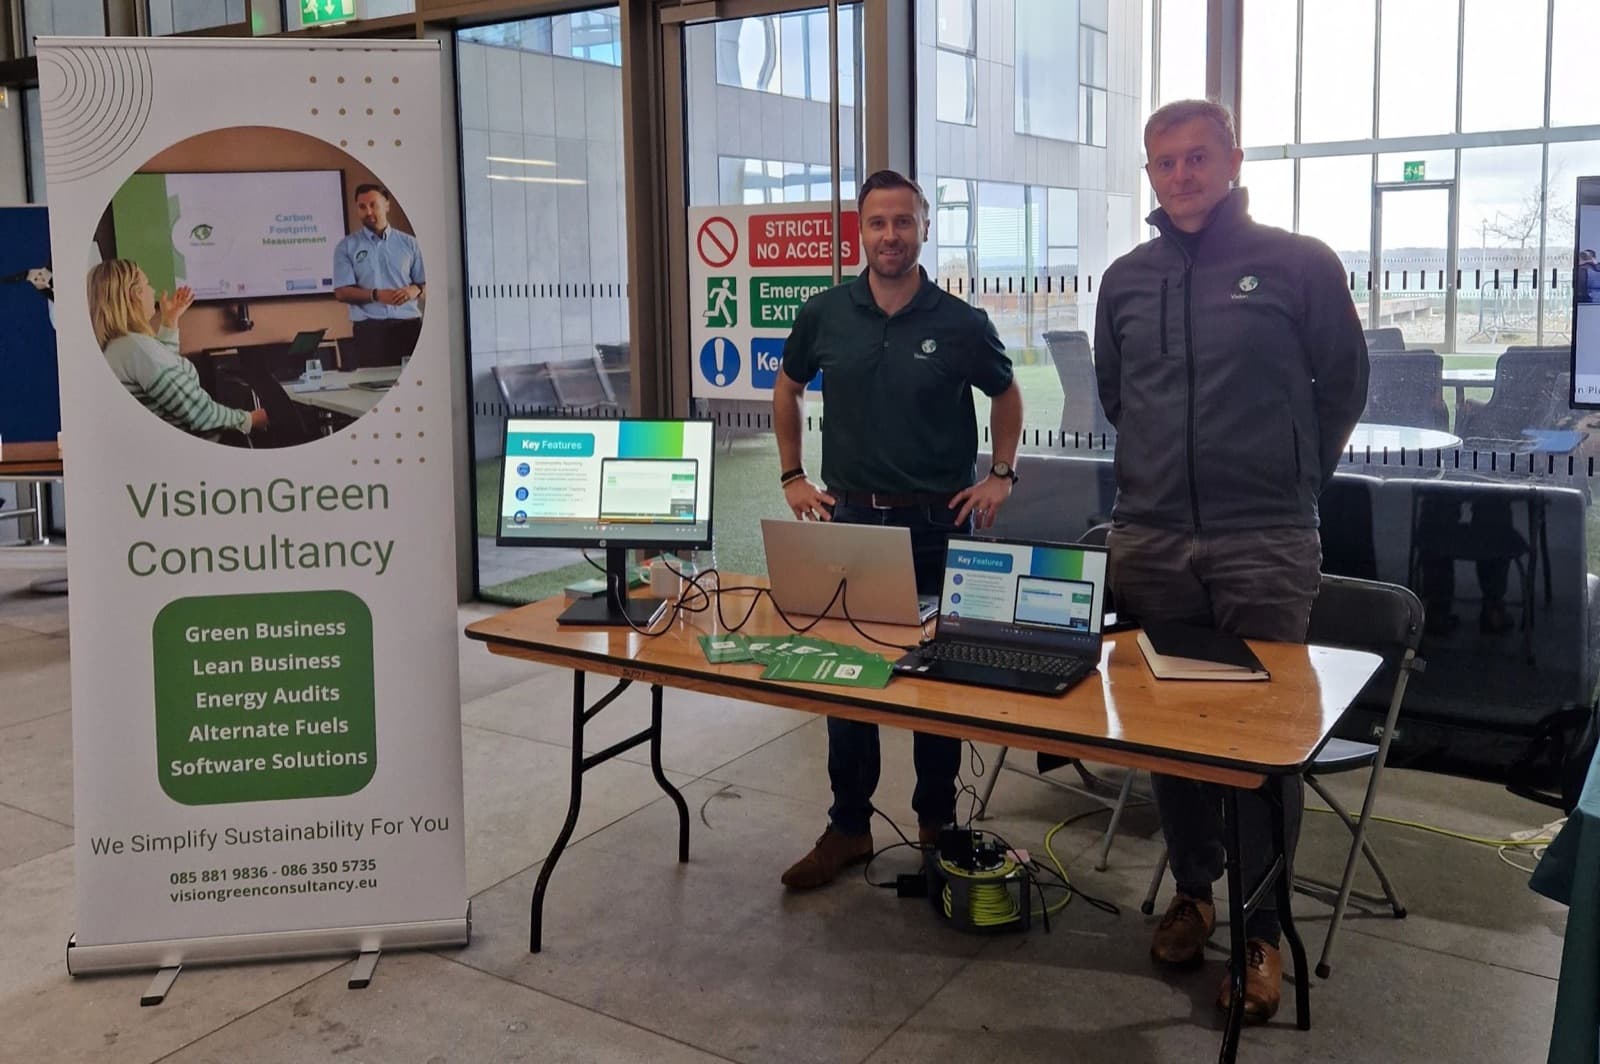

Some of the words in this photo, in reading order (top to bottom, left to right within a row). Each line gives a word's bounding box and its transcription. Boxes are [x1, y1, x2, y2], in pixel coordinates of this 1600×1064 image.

[269, 223, 318, 235] Footprint
[275, 213, 313, 223] Carbon
[765, 219, 833, 238] STRICTL
[262, 236, 327, 246] Measurement
[757, 243, 780, 260] NO
[761, 304, 799, 321] EXIT
[757, 351, 784, 371] Ke
[522, 439, 540, 452] Key
[541, 440, 582, 450] Features
[126, 478, 390, 519] VisionGreen
[127, 534, 395, 577] Consultancy
[957, 556, 971, 566] Key
[972, 556, 1003, 568] Features
[185, 625, 250, 643] Green
[255, 620, 347, 641] Business
[193, 657, 244, 676] Lean
[250, 653, 341, 673] Business
[196, 689, 268, 710] Energy
[273, 685, 340, 705] Audits
[188, 720, 290, 743] Alternate
[295, 717, 349, 737] Fuels
[170, 754, 266, 777] Software
[272, 750, 368, 771] Solutions
[91, 836, 124, 856] We
[131, 828, 218, 854] Simplify
[224, 820, 365, 847] Sustainability
[371, 818, 404, 836] For
[410, 815, 450, 833] You
[170, 872, 197, 886] 085
[202, 869, 228, 883] 881
[232, 866, 268, 881] 9836
[281, 863, 308, 878] 086
[312, 861, 338, 875] 350
[342, 858, 377, 873] 5735
[170, 876, 378, 902] visiongreenconsultancy.eu
